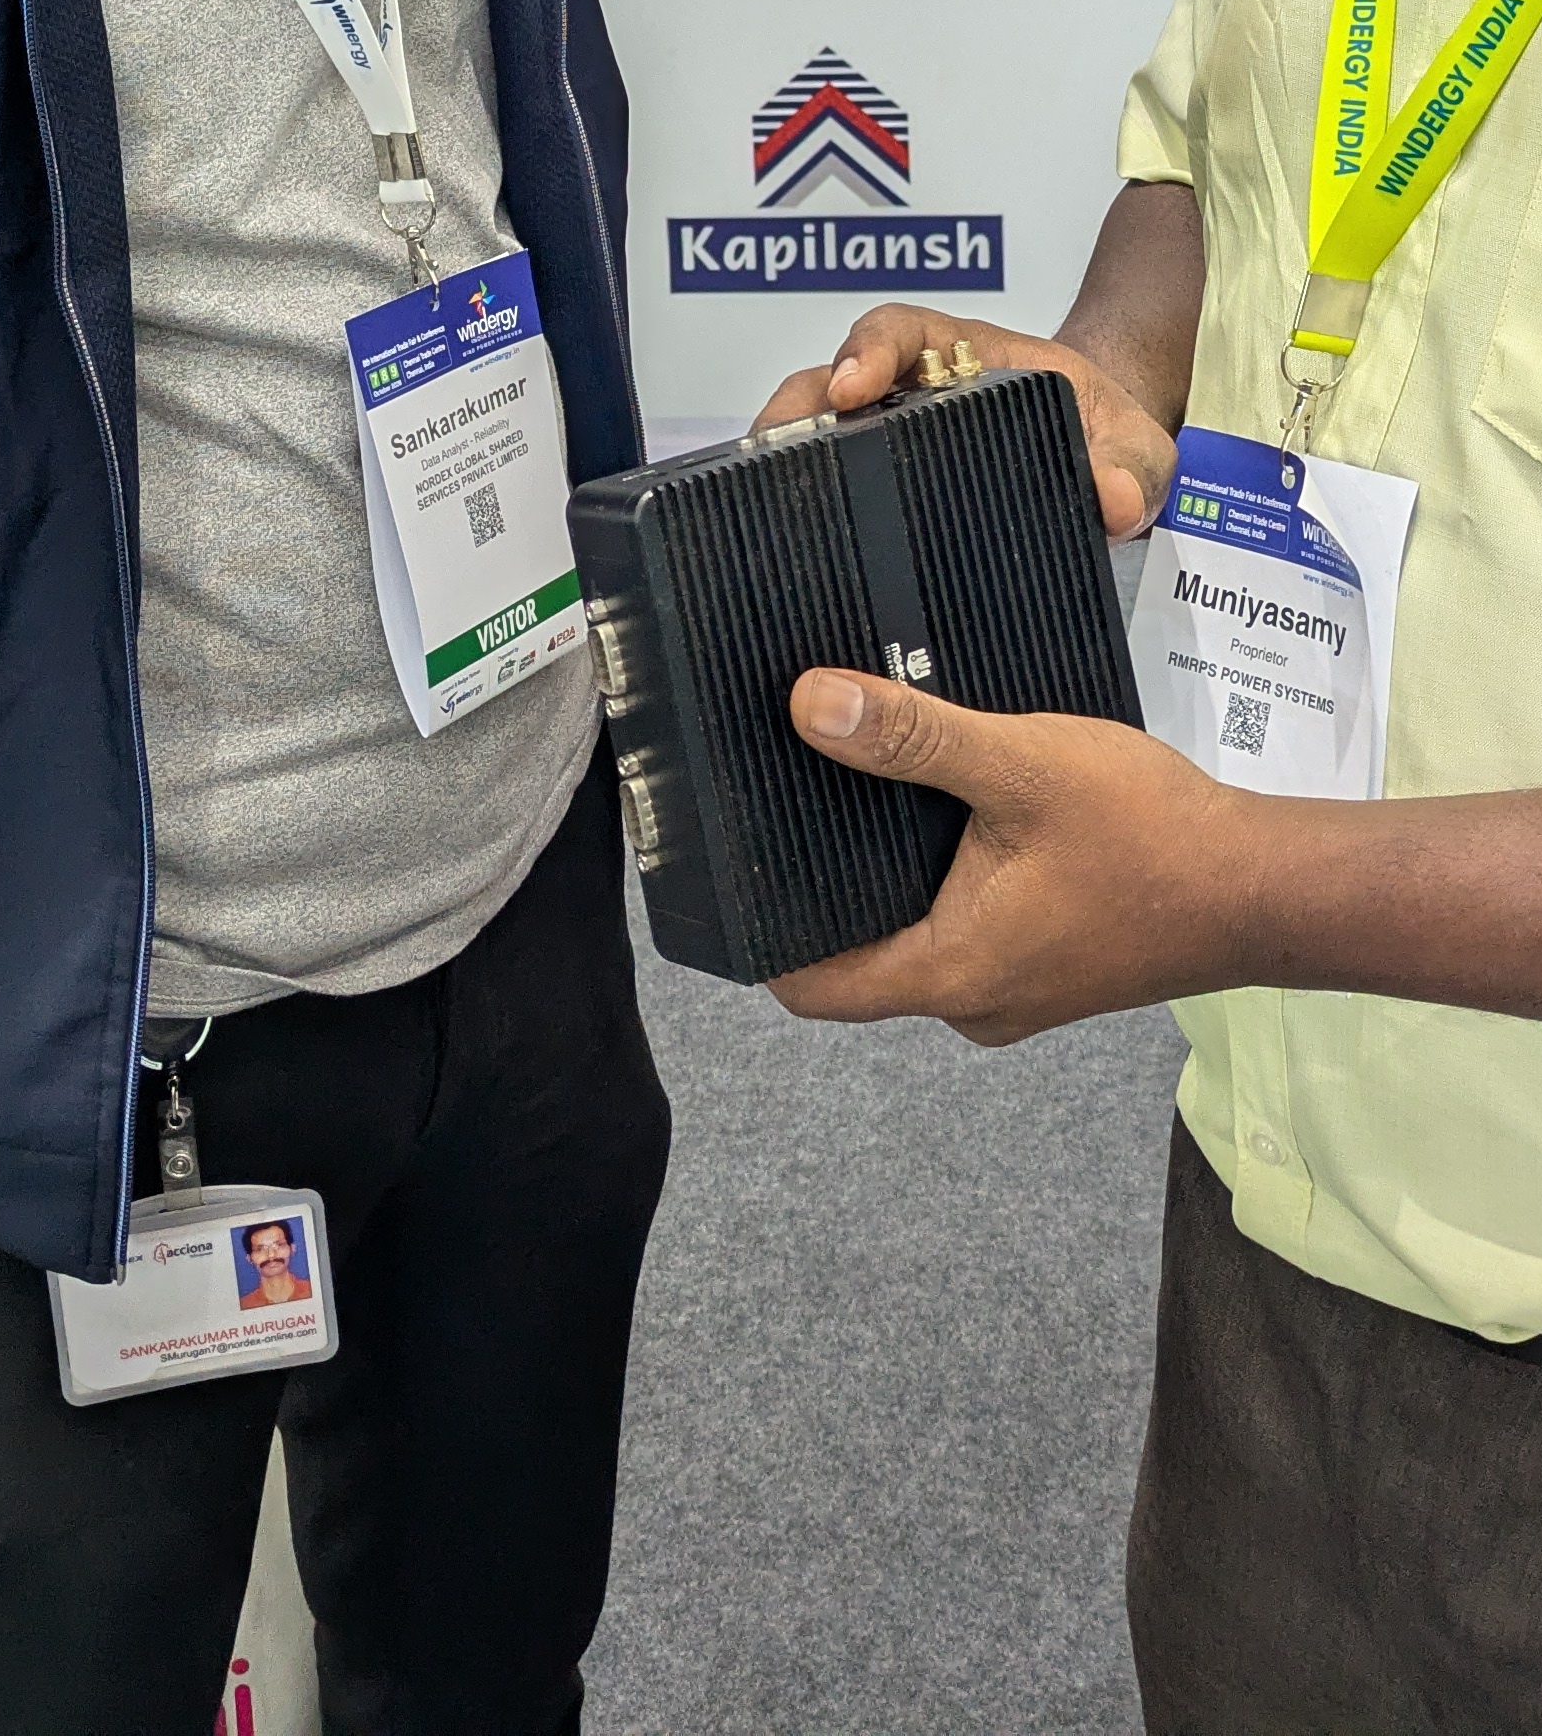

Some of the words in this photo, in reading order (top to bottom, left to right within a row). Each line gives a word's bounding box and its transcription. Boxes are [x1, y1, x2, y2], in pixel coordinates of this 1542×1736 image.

[332, 4, 371, 70] winergy
[1334, 97, 1370, 177] INDIA
[1376, 70, 1470, 199] WINDERGY
[680, 221, 991, 282] Kapilansh
[457, 306, 518, 342] windergy
[391, 376, 527, 460] Sankarakumar
[420, 453, 440, 471] Data
[441, 434, 469, 463] Analyst
[474, 418, 510, 444] Reliability
[415, 469, 453, 496] NORDEX
[454, 450, 488, 476] GLOBAL
[489, 430, 524, 455] SHARED
[417, 480, 460, 512] SERVICES
[461, 461, 496, 488] PRIVATE
[497, 443, 529, 467] LIMITED
[476, 598, 538, 653] VISITOR
[1173, 569, 1347, 657] Muniyasamy
[1167, 651, 1217, 679] RMRPS
[1220, 666, 1272, 695] POWER
[1274, 682, 1335, 716] SYSTEMS
[1230, 637, 1288, 668] Proprietor
[166, 1240, 213, 1259] acciona
[119, 1327, 239, 1360] SANKARAKUMAR
[243, 1314, 316, 1338] MURUGAN
